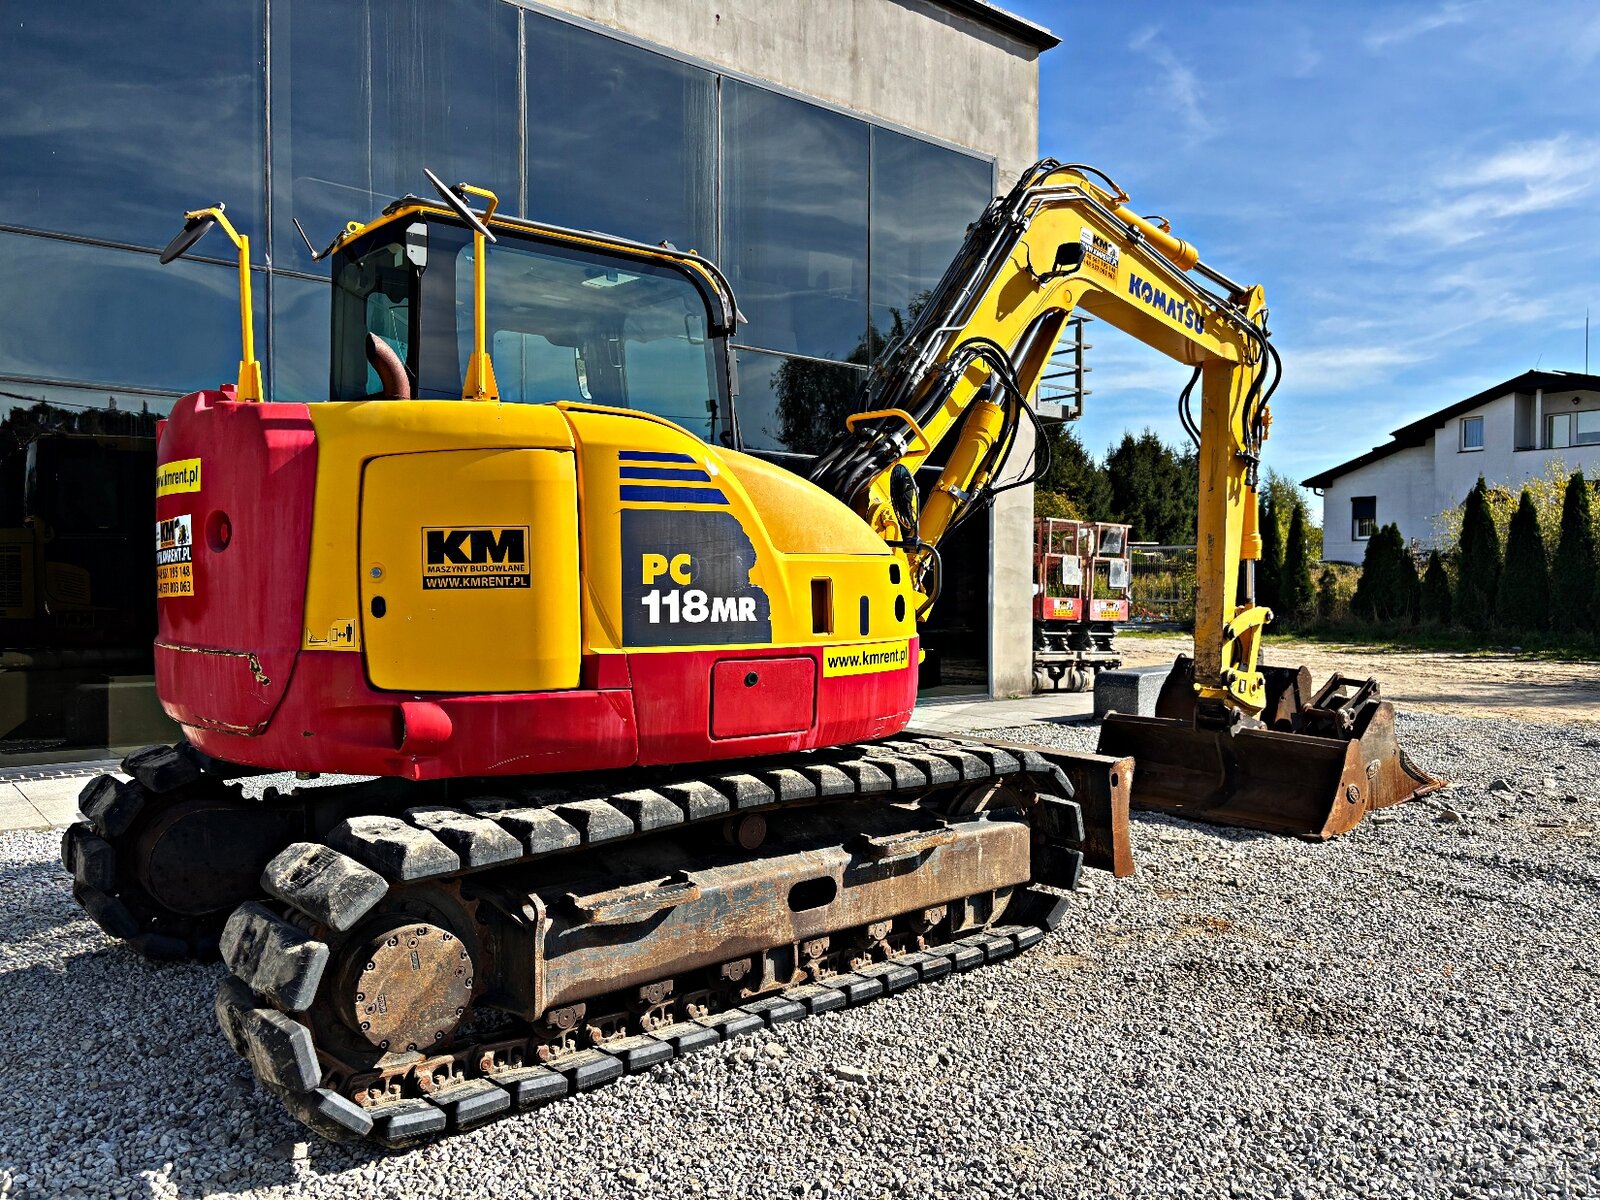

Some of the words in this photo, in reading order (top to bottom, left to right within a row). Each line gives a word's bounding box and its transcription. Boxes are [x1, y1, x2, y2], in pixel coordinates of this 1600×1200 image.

[1093, 234, 1108, 250] KM
[1128, 273, 1205, 335] KOMATSU
[160, 520, 175, 542] KM
[427, 529, 525, 564] KM
[179, 565, 191, 577] 148
[427, 565, 468, 573] MASZYNY
[470, 564, 525, 573] BUDOWLANE
[642, 553, 692, 586] PC
[180, 580, 191, 592] 063
[426, 576, 527, 588] WWW.KMRENT.PL
[827, 646, 908, 668] www.kmrent.pl
